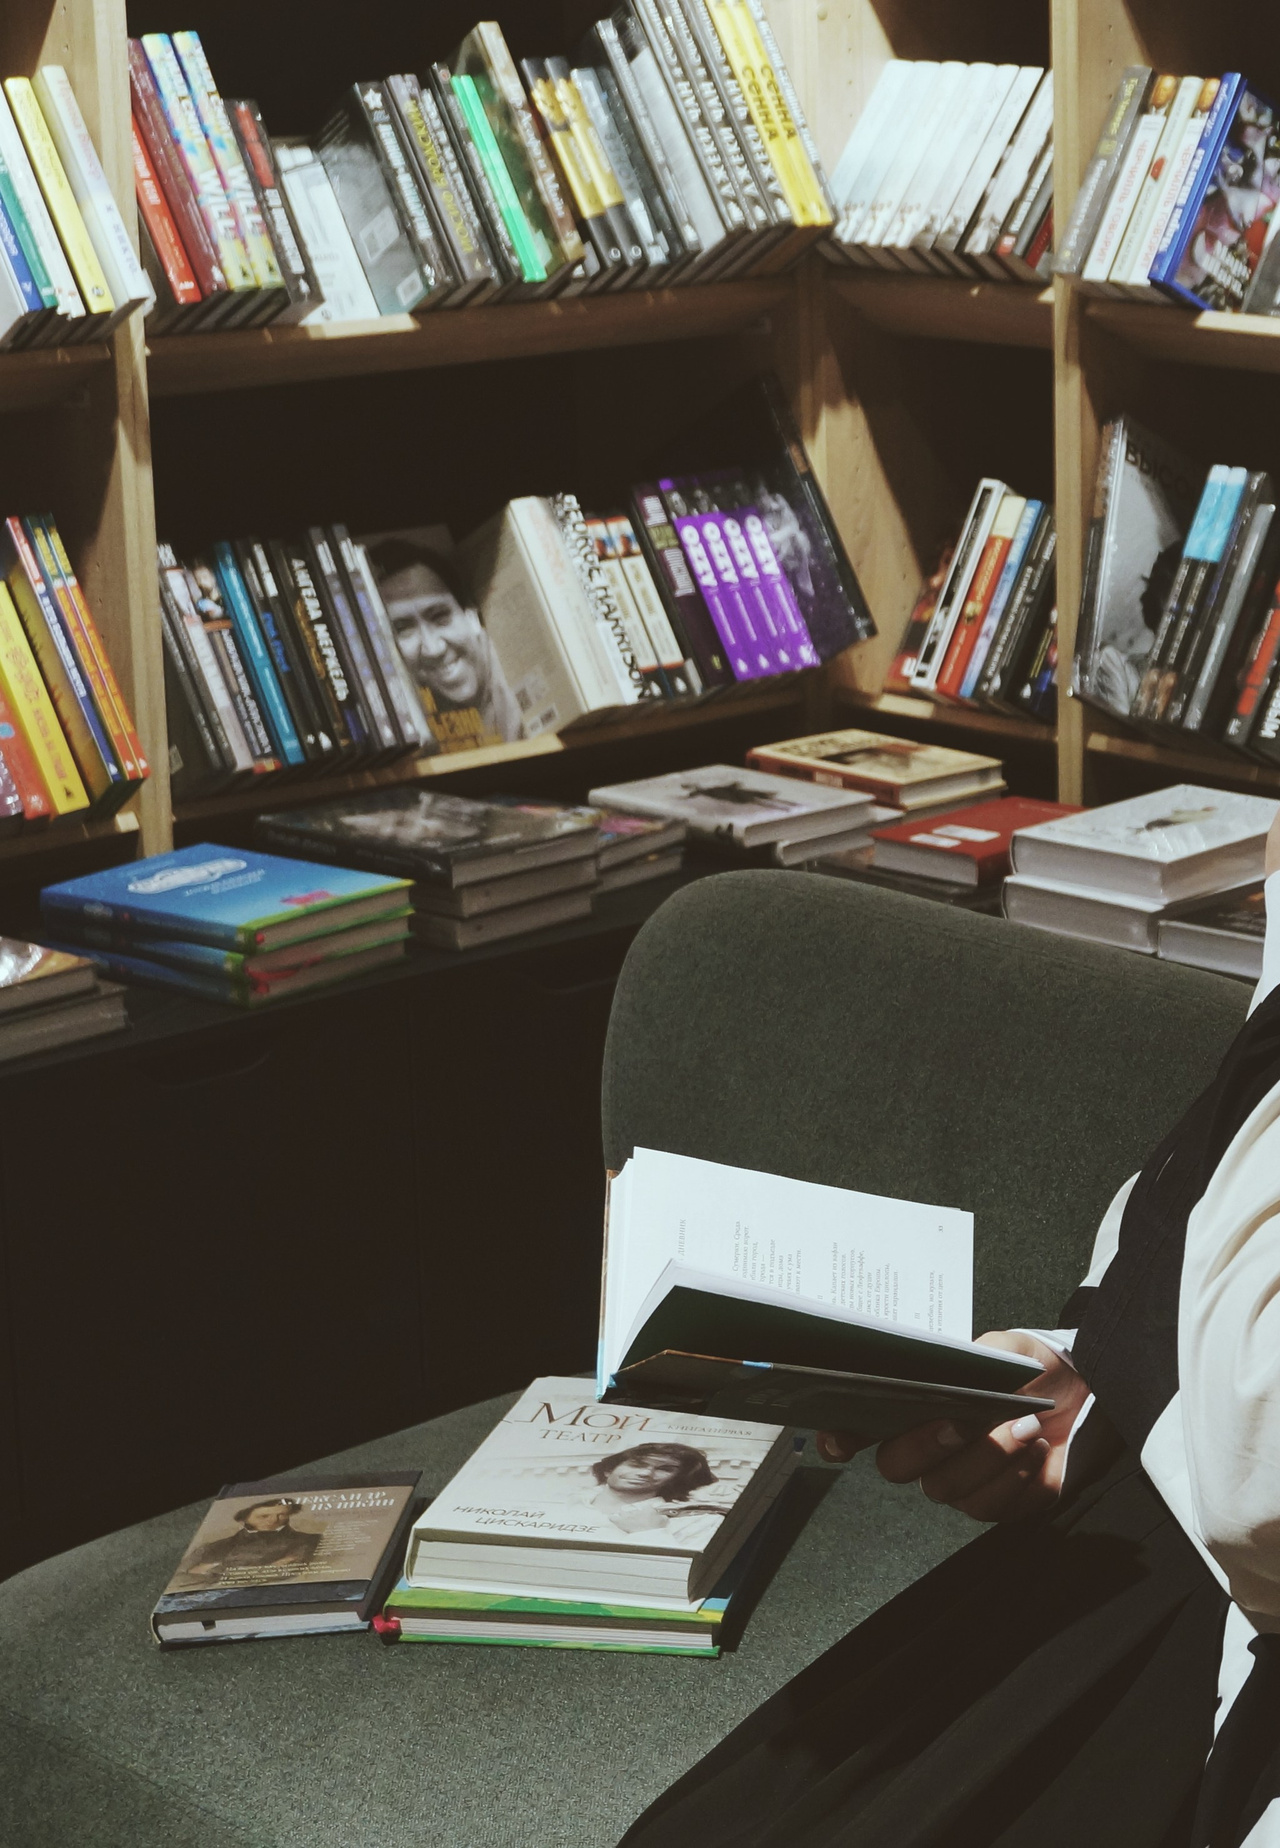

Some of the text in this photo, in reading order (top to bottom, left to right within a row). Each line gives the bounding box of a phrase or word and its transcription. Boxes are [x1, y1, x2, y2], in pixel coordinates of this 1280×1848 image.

[401, 98, 449, 189] БРОДСКИЙ
[676, 79, 735, 200] ДЖЕКИ ЧАН
[700, 79, 758, 199] ДЖЕКИ ЧАН
[724, 77, 782, 196] ДЖЕКИ ЧАН
[198, 168, 235, 233] WILL
[226, 162, 262, 229] WILL
[1095, 138, 1149, 264] ЧЕРЧИЛЛЬ ГОВОРИТ
[1162, 141, 1195, 208] ЧЕРЧИЛЛЬ
[439, 190, 475, 253] ИОСИФ
[1139, 211, 1168, 269] ГОВОРИТ
[561, 492, 648, 700] GEORGE HARRISON
[291, 555, 350, 700] АНГЕЛА МЕРКЕЛЬ
[732, 1242, 740, 1271] Сумерки.
[856, 1250, 865, 1289] Люфтваффе,
[929, 1294, 934, 1302] но
[938, 1291, 942, 1299] от
[540, 1429, 622, 1444] ТЕАТР
[667, 1424, 706, 1435] КНИГА
[280, 1491, 386, 1506] АЛЕКСАНДР
[310, 1499, 395, 1511] ПУШКИН
[453, 1505, 546, 1519] НИКОЛАЙ
[475, 1517, 601, 1534] ЦИСКАРИДЗЕ
